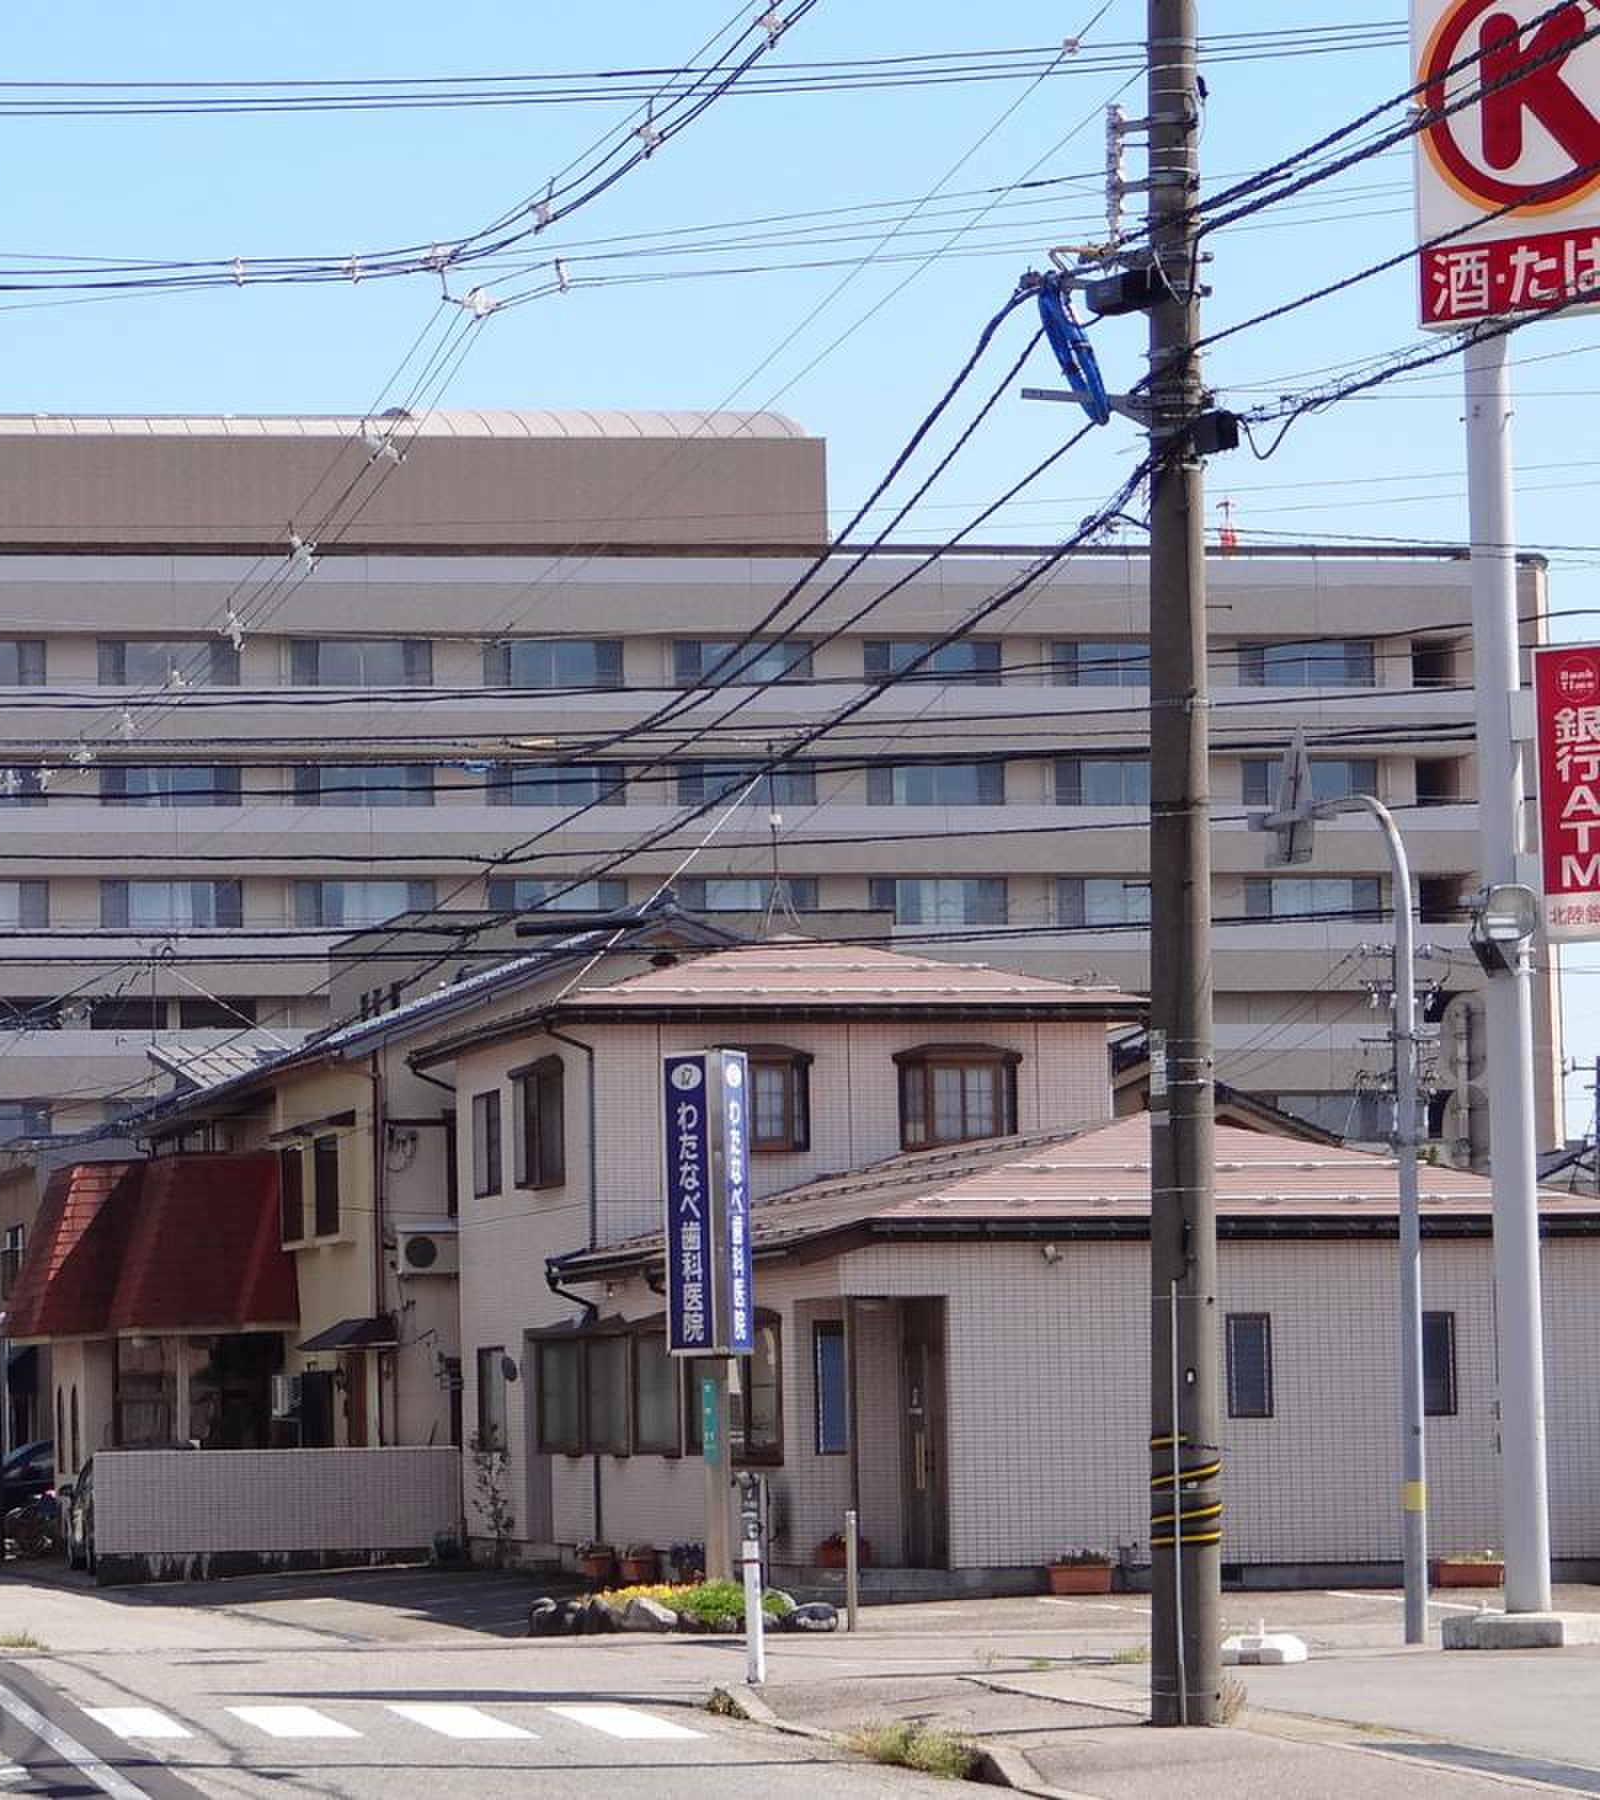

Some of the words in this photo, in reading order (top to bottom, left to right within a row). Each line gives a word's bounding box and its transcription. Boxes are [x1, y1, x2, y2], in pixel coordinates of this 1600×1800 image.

[676, 1101, 705, 1343] わたなべ歯科医院
